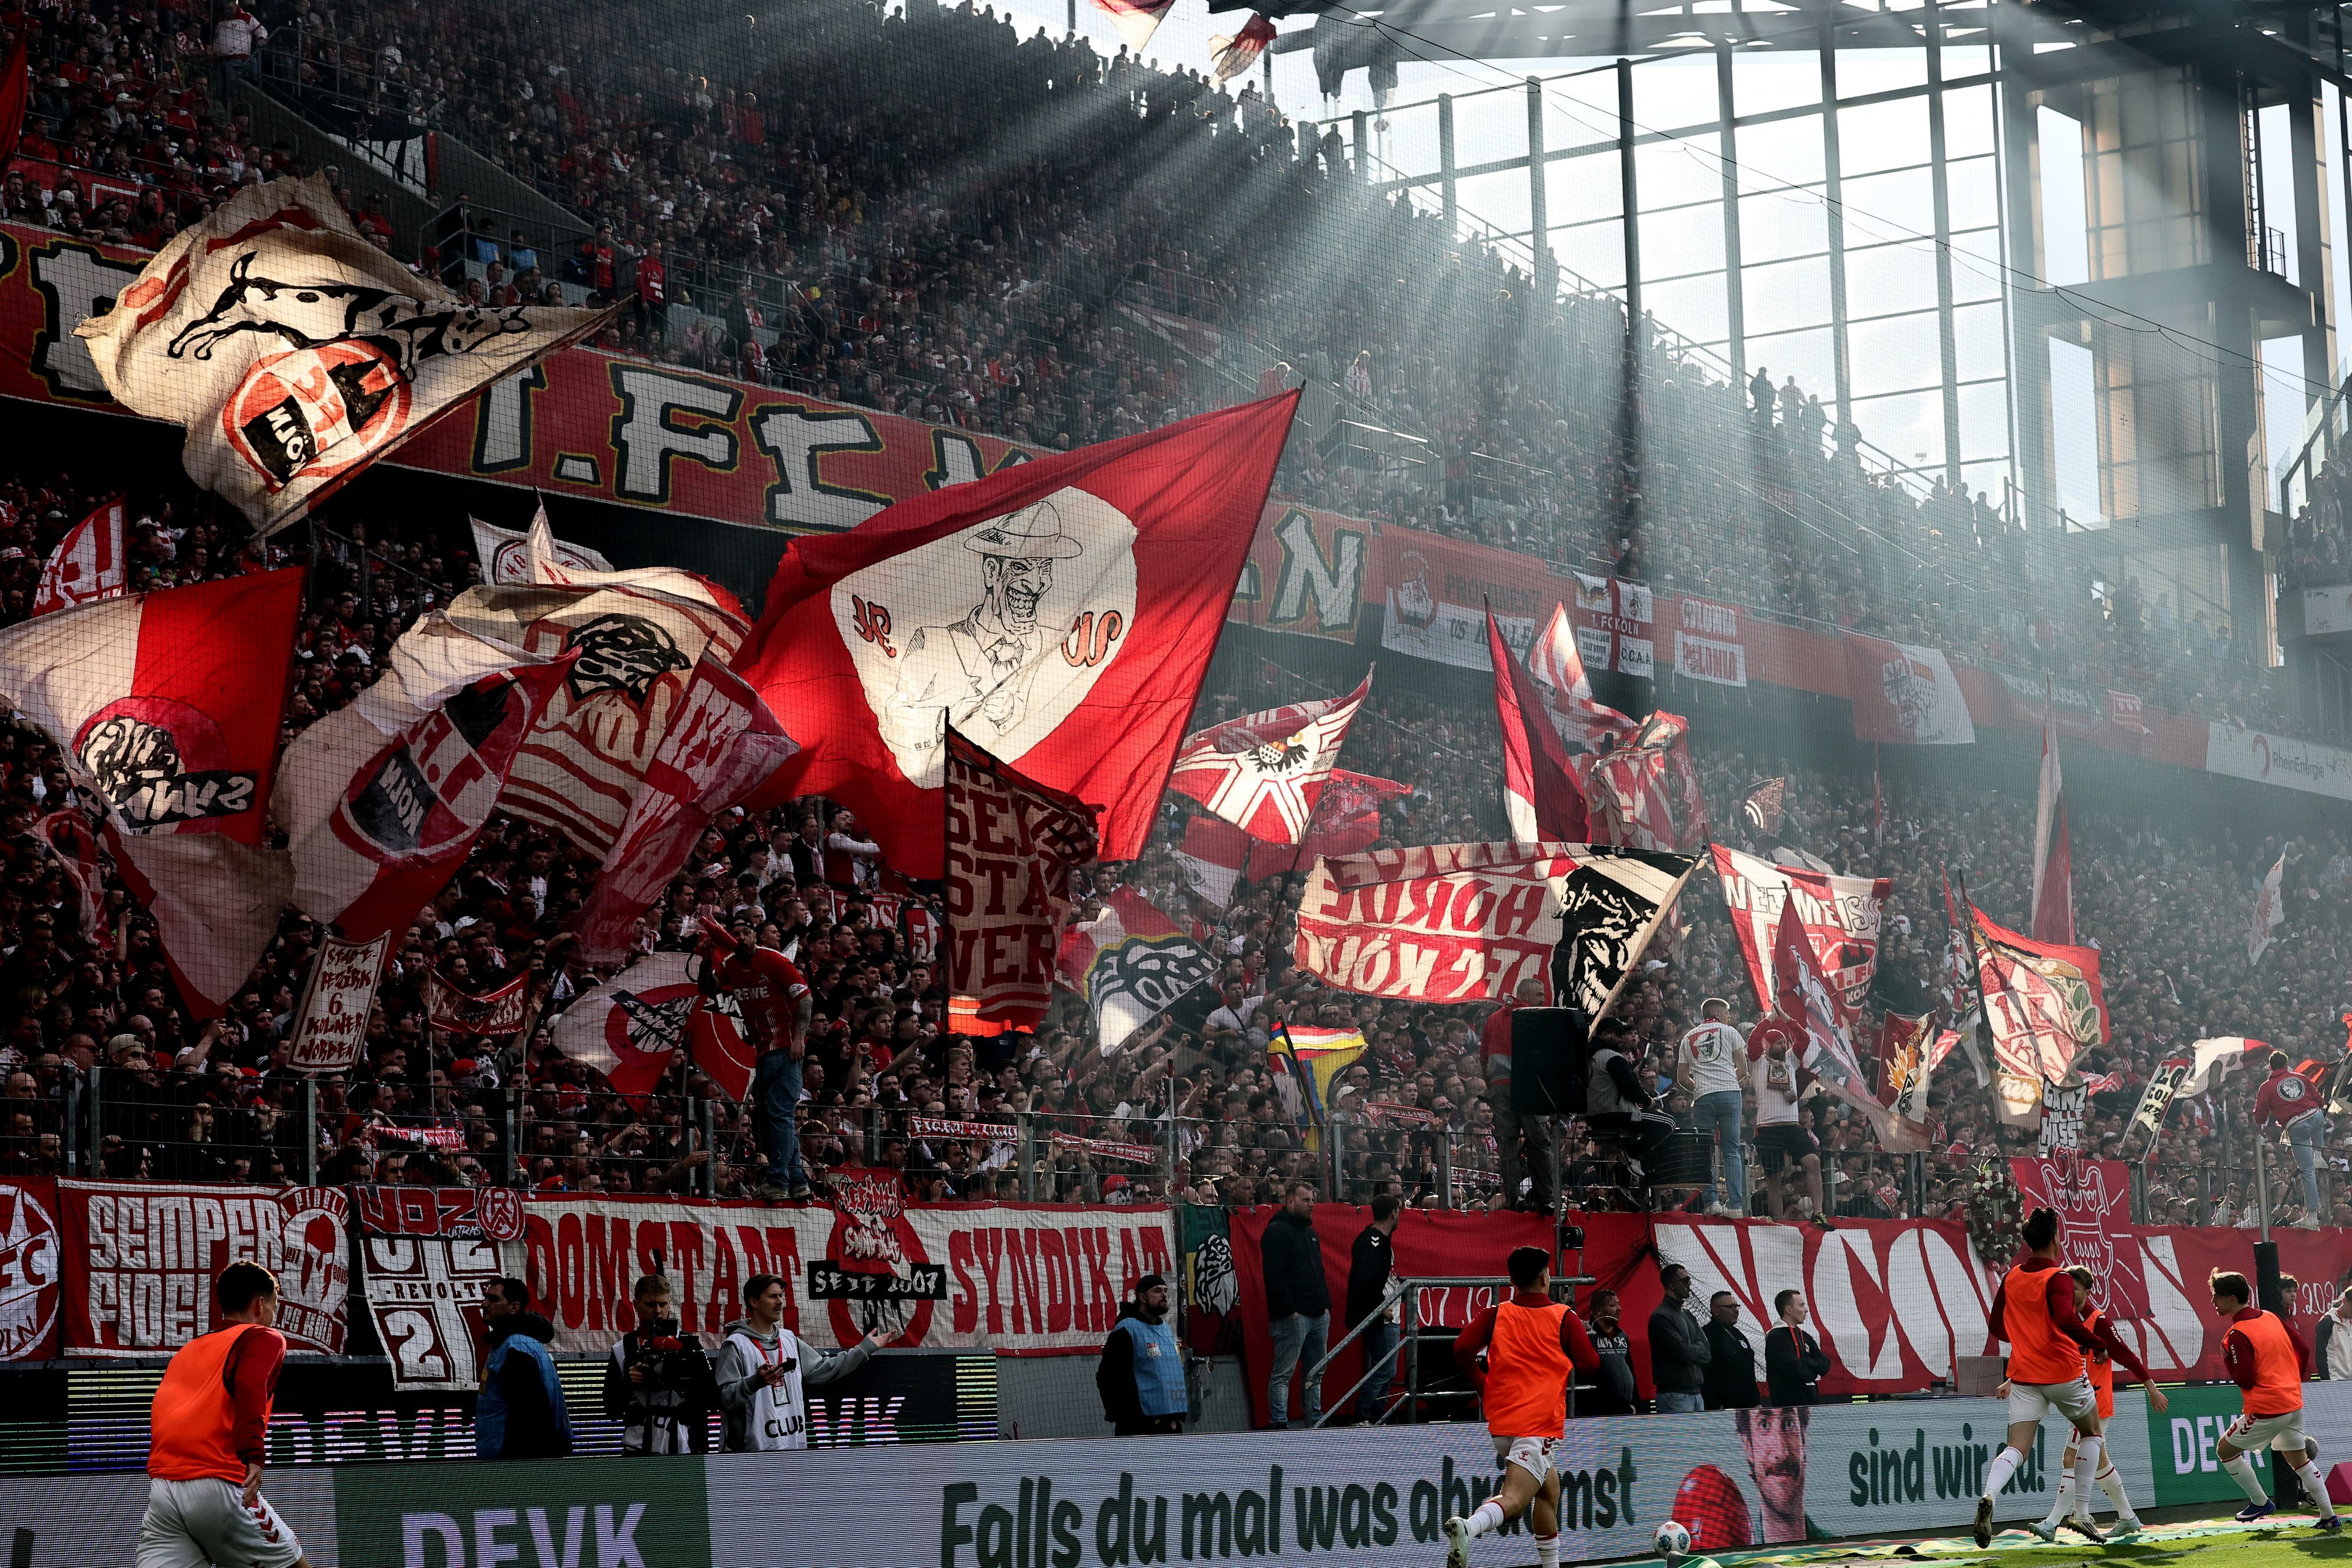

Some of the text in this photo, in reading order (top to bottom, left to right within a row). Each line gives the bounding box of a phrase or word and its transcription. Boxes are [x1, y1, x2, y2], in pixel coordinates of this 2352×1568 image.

[1615, 617, 1639, 636] KÖLN
[329, 992, 343, 1016] 6
[734, 985, 770, 1001] REWE
[296, 1036, 357, 1062] NORDEN
[2043, 1080, 2087, 1111] GANZ
[88, 1194, 284, 1271] SEMPER
[526, 1212, 802, 1337] DOMSTADT
[2229, 1344, 2238, 1364] DEVK
[764, 1415, 804, 1439] CLUB
[1849, 1429, 1925, 1508] sind
[1932, 1423, 1989, 1499] wir
[941, 1446, 1639, 1568] Falls du mal was abrmst
[402, 1503, 647, 1568] DEVK
